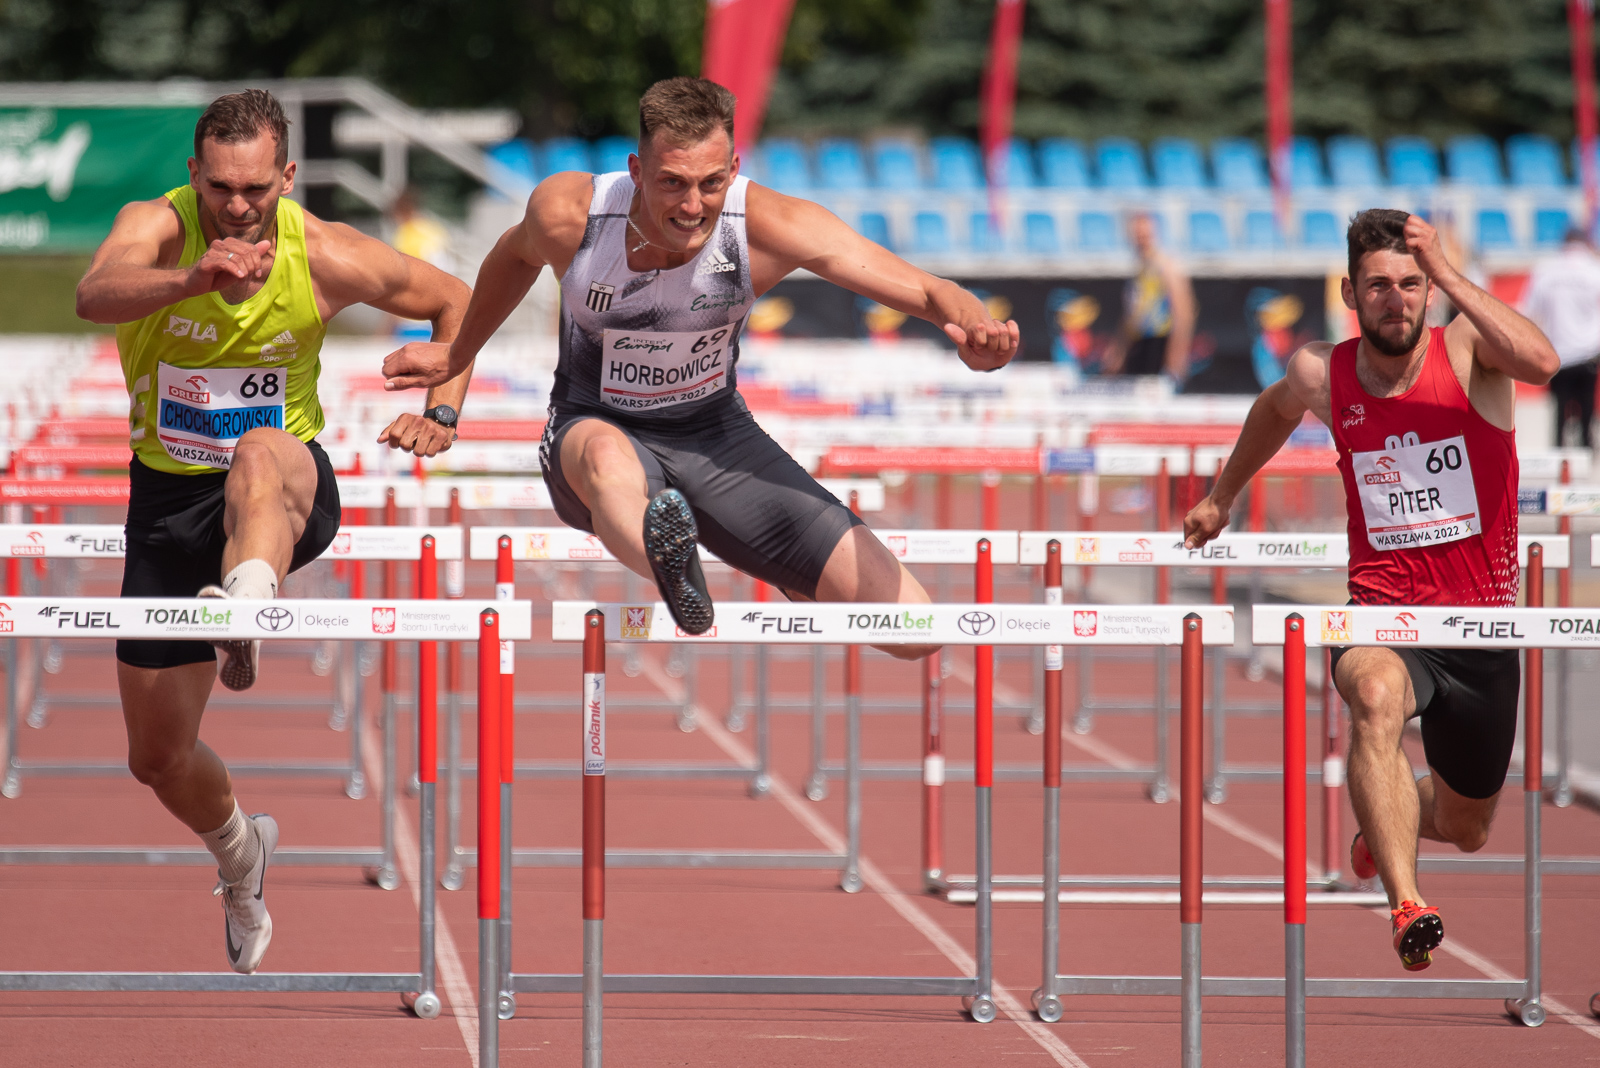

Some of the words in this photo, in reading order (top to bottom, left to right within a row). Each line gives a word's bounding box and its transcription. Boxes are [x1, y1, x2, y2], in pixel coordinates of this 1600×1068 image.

[697, 263, 736, 275] adidas
[690, 294, 746, 311] Europol
[613, 336, 674, 354] Europol
[691, 329, 728, 354] 69
[609, 349, 722, 387] HORBOWICZ
[239, 373, 280, 399] 68
[170, 387, 209, 403] ORLEN
[610, 395, 677, 408] WARSZAWA
[680, 386, 707, 401] 2022
[164, 403, 277, 436] CHOCHOROWSKI
[166, 444, 230, 465] WARSZAWA
[1425, 444, 1463, 475] 60
[1366, 472, 1400, 485] ORLEN
[1388, 487, 1443, 516] PITER
[1375, 532, 1432, 546] WARSZAWA
[1434, 525, 1460, 540] 2022
[12, 547, 44, 555] ORLEN
[1119, 553, 1152, 561] ORLEN
[58, 611, 120, 628] FUEL
[304, 613, 349, 629] Okęcie
[401, 612, 451, 621] Ministerstwo
[1006, 618, 1051, 632] Okęcie
[1103, 615, 1152, 623] Ministerstwo
[401, 623, 428, 632] Sportu
[433, 623, 469, 633] Turystyki
[761, 617, 823, 634] FUEL
[1103, 626, 1130, 635] Sportu
[1135, 625, 1170, 636] Turystyki
[1463, 621, 1525, 638] FUEL
[1377, 630, 1417, 640] ORLEN
[588, 700, 603, 757] polanik
